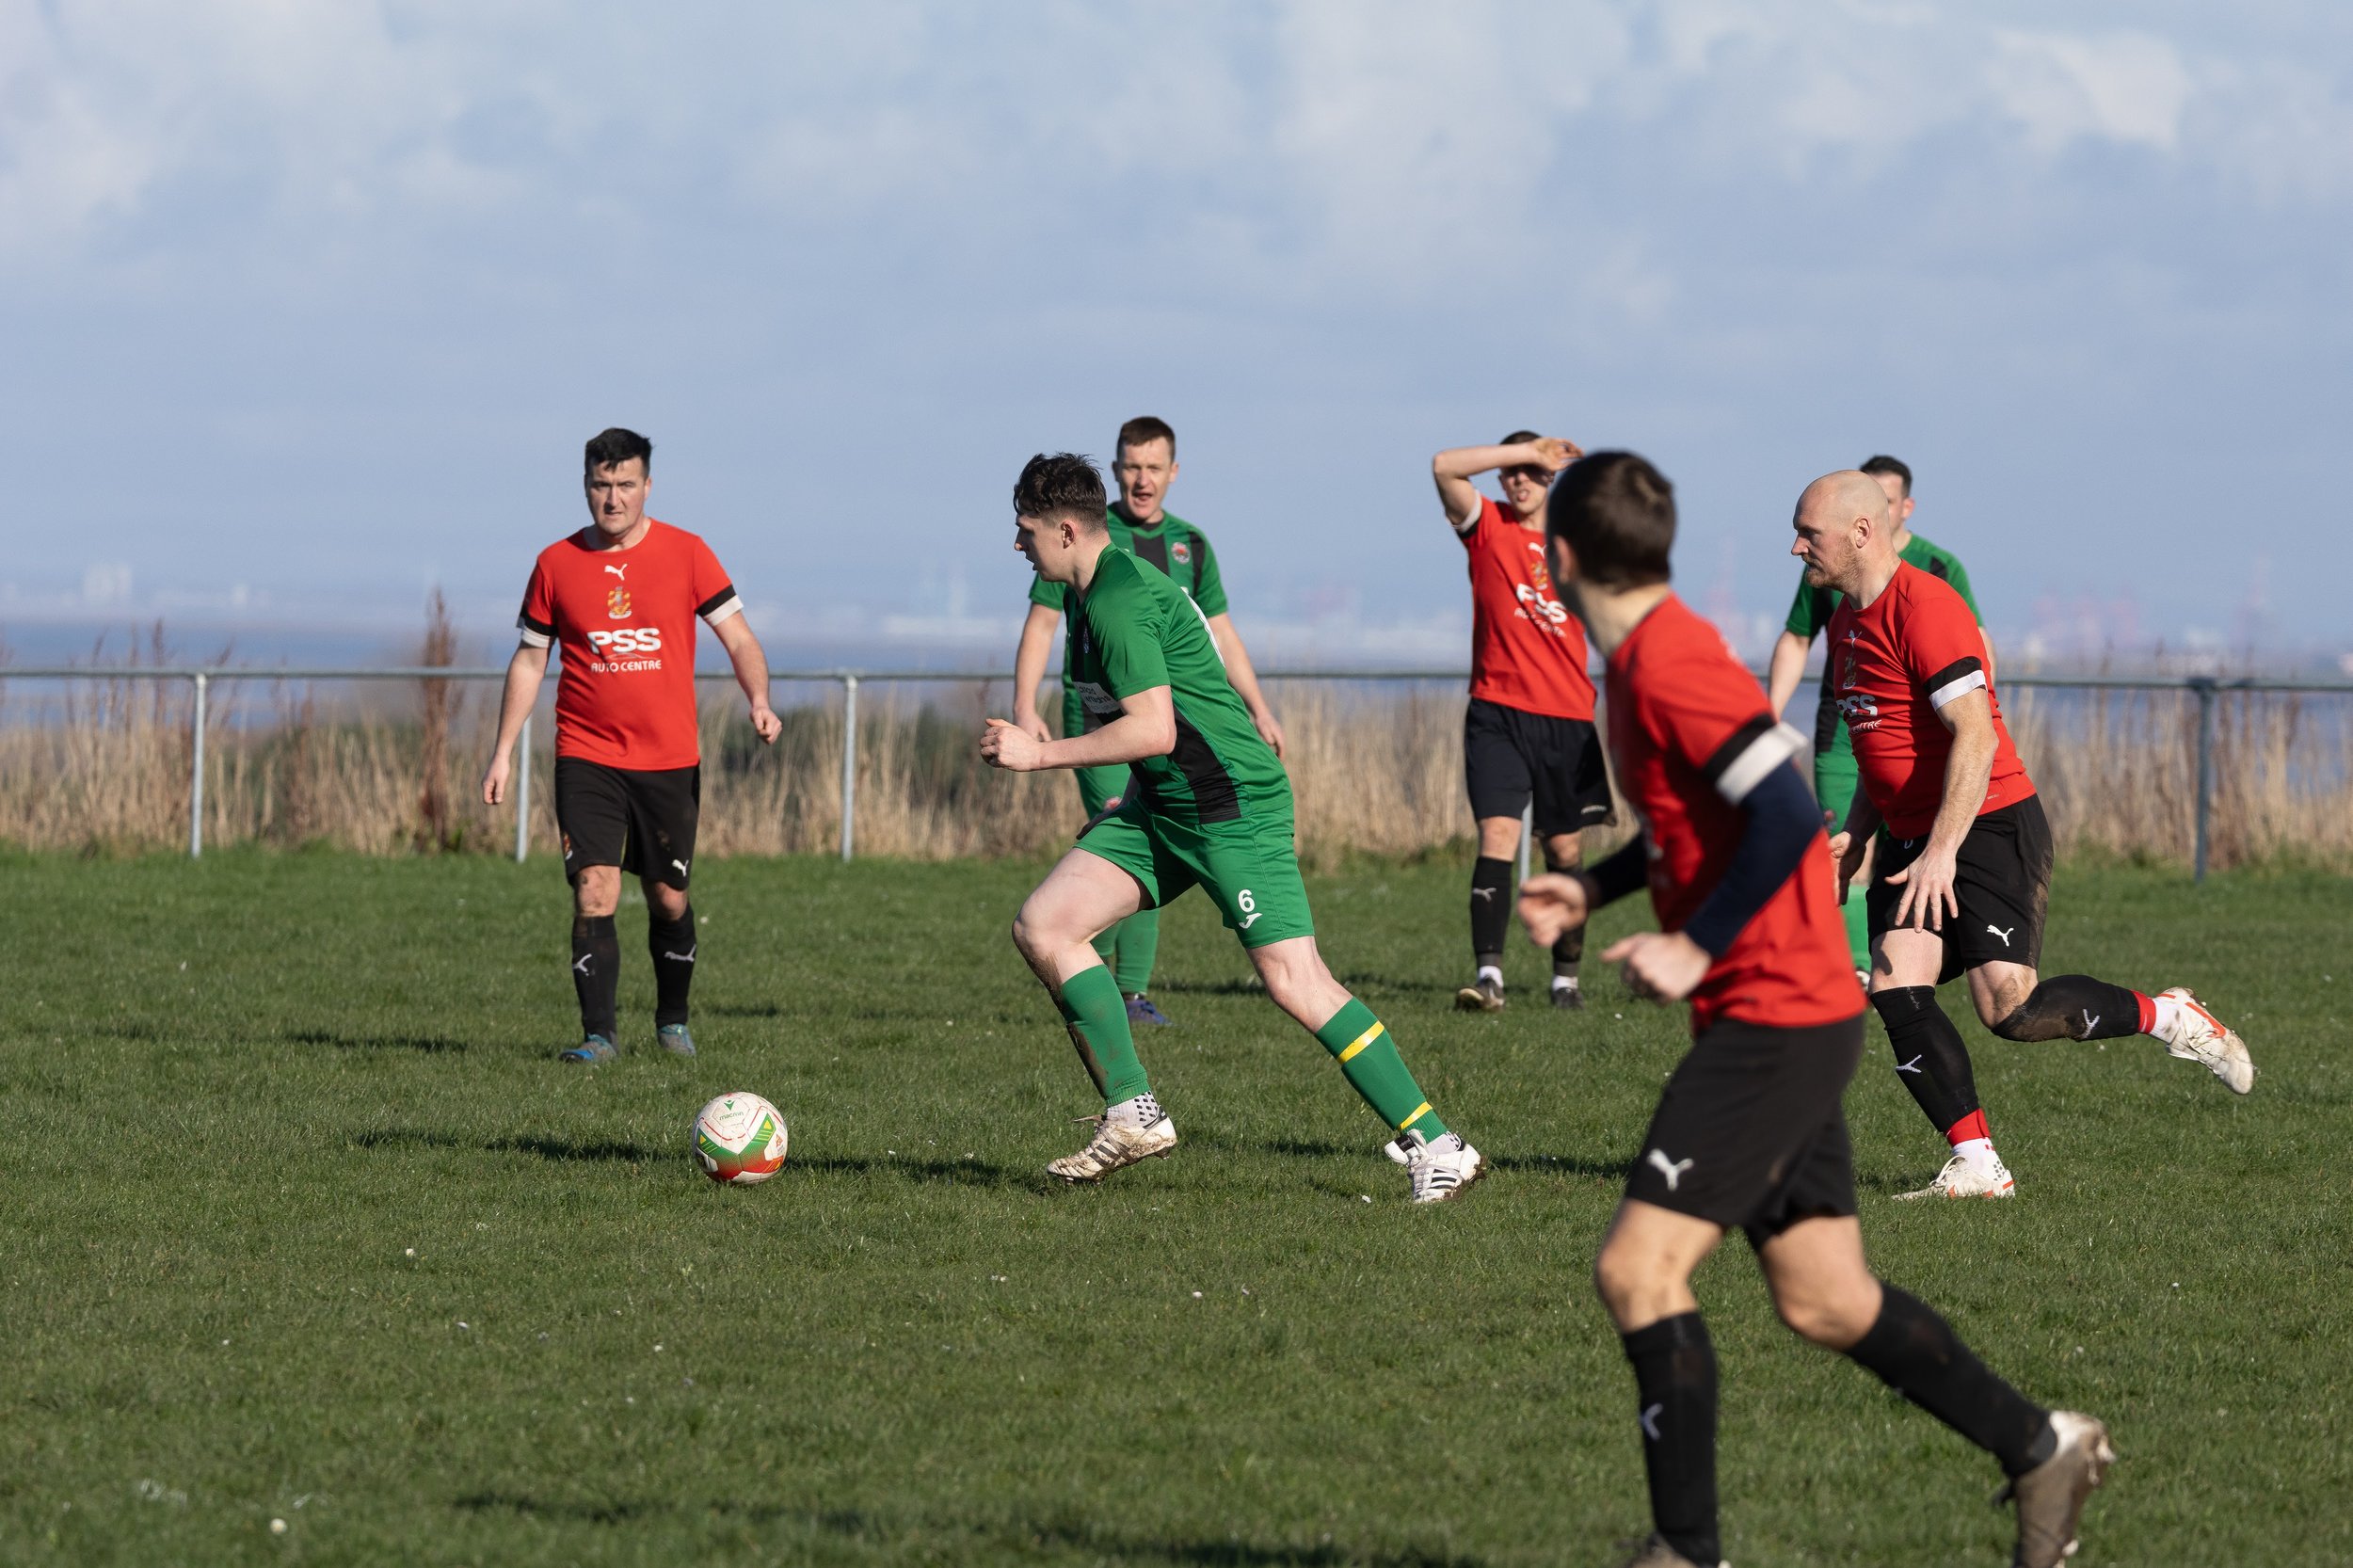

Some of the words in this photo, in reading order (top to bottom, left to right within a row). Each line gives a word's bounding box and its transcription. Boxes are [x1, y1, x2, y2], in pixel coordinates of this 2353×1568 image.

[586, 628, 662, 654] PSS
[620, 660, 662, 671] CENTRE
[1238, 888, 1256, 913] 6
